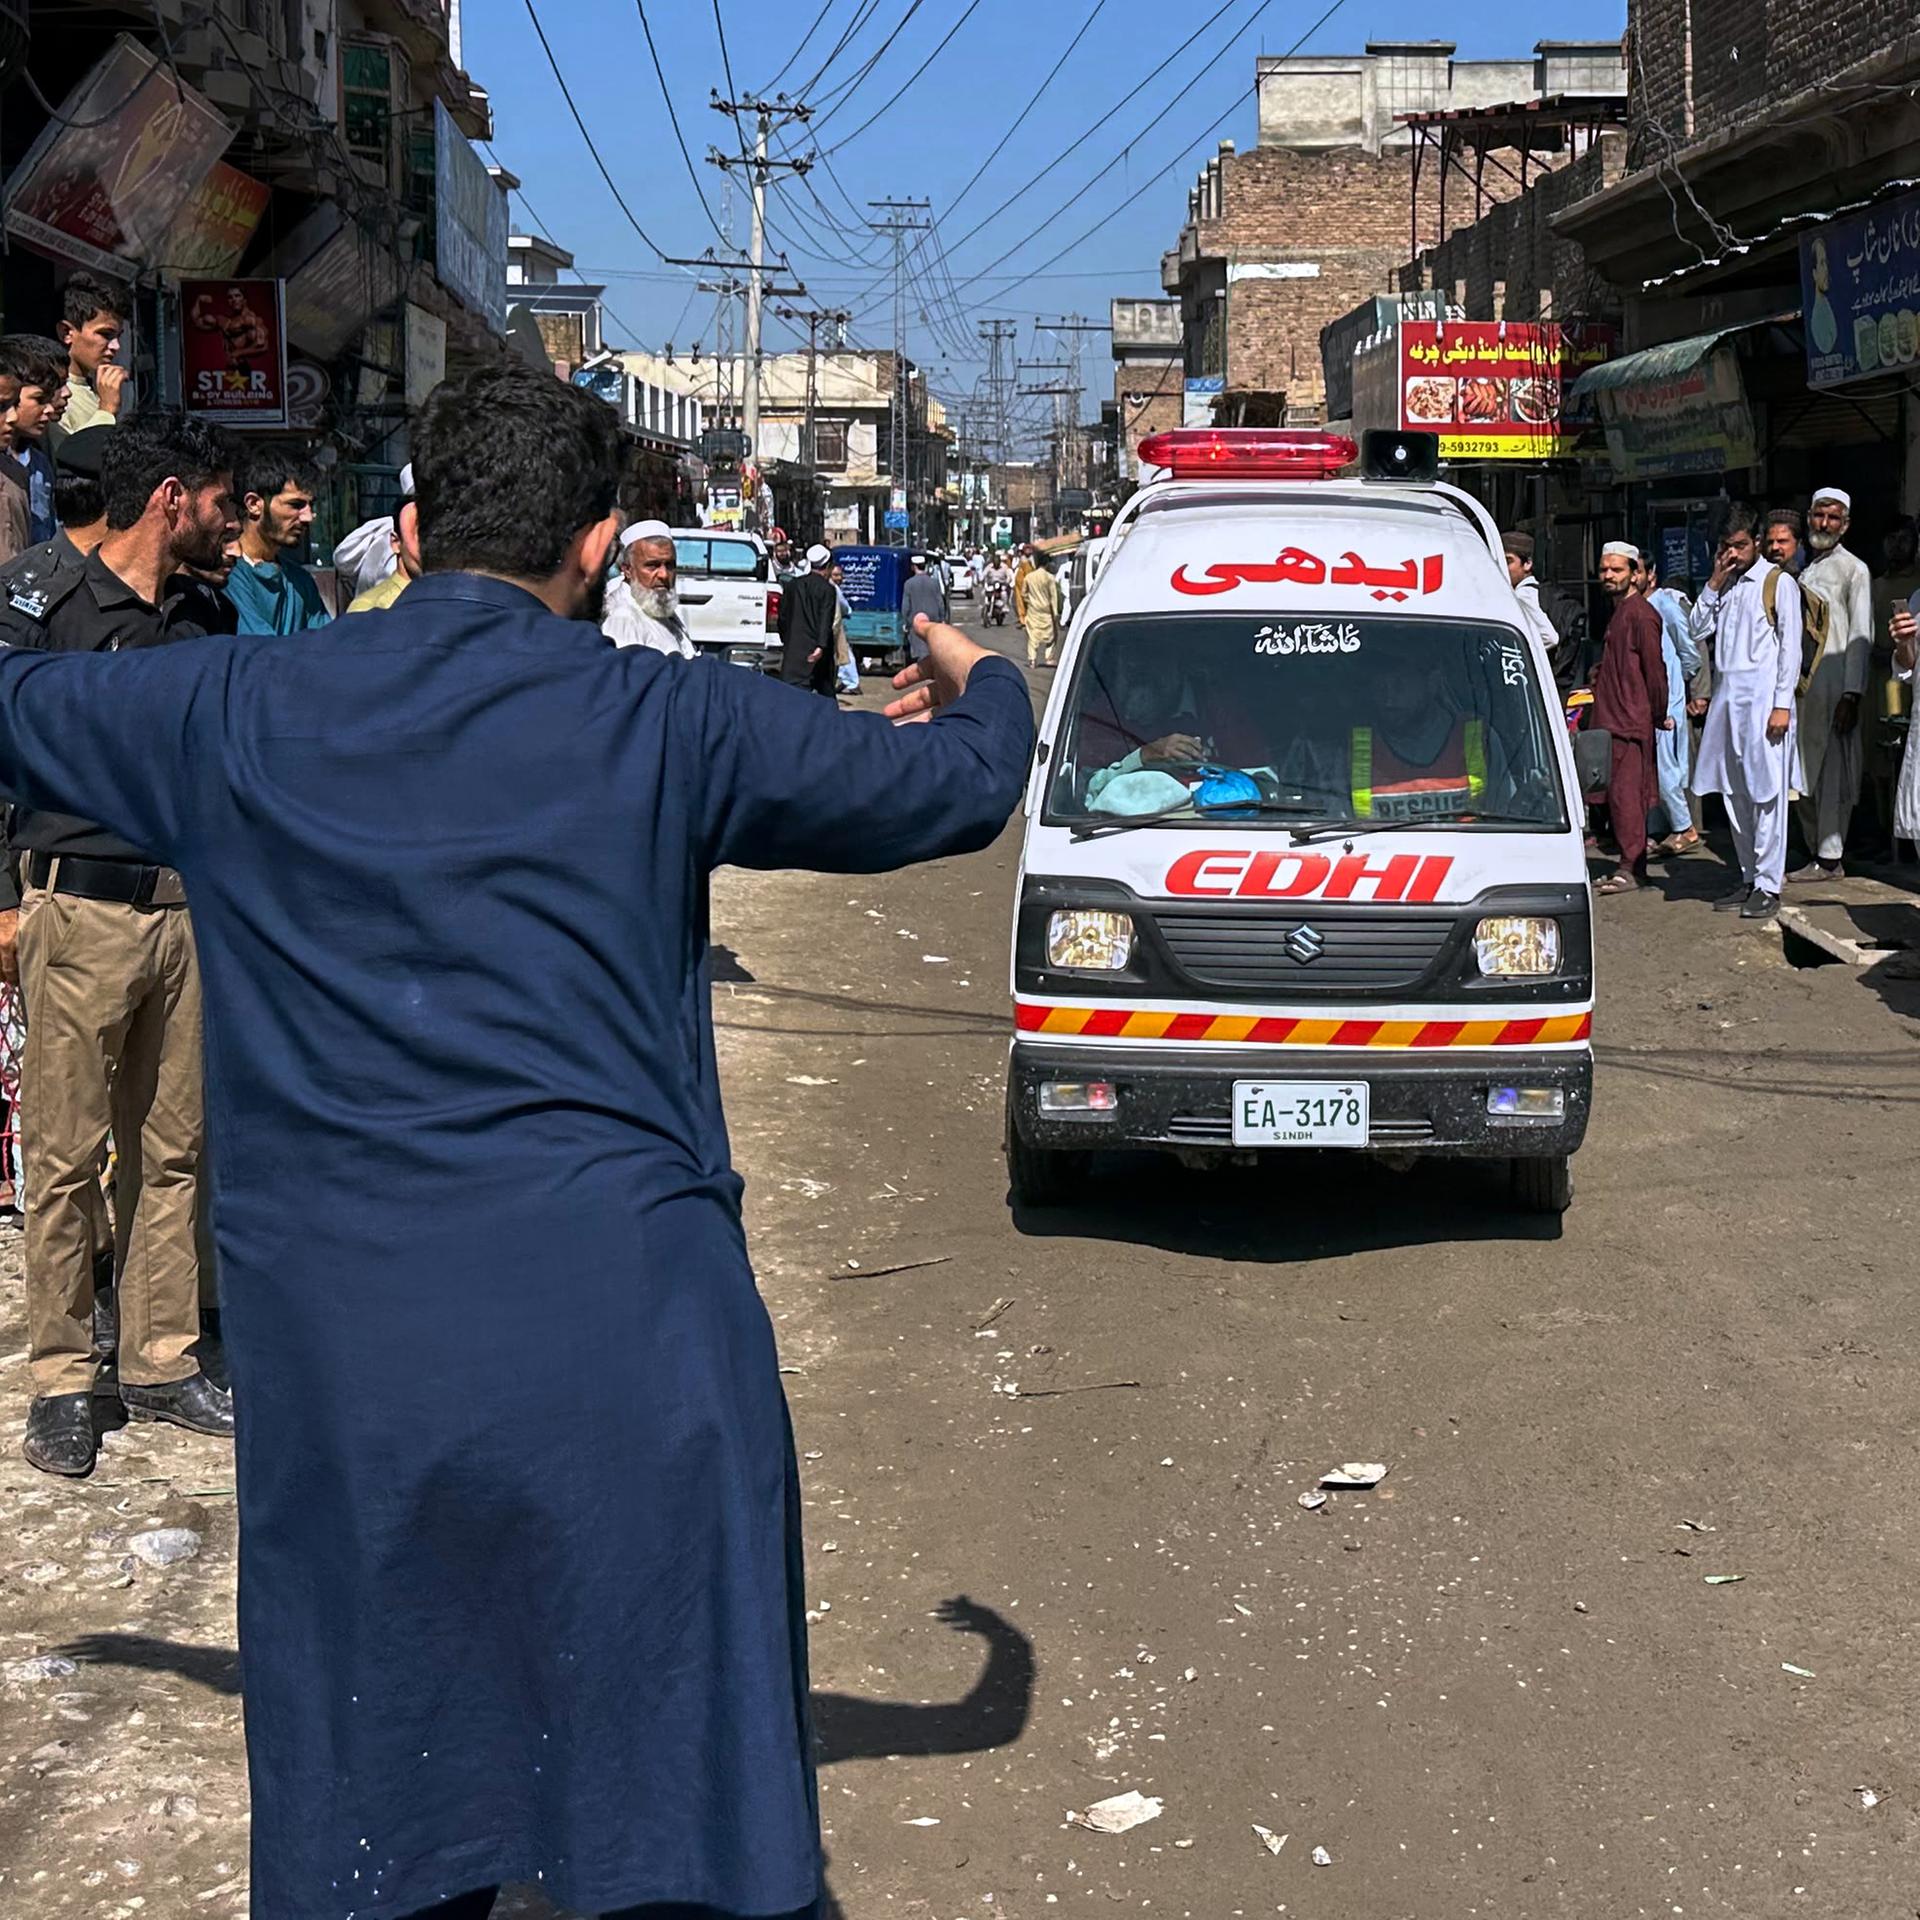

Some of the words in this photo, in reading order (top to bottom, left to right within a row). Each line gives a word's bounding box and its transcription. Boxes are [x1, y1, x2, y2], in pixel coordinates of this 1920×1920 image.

[1171, 546, 1443, 602] ایدھی
[1165, 849, 1454, 904] EDHI
[1243, 1098, 1361, 1128] EA-3178
[1273, 1131, 1313, 1140] SINDH
